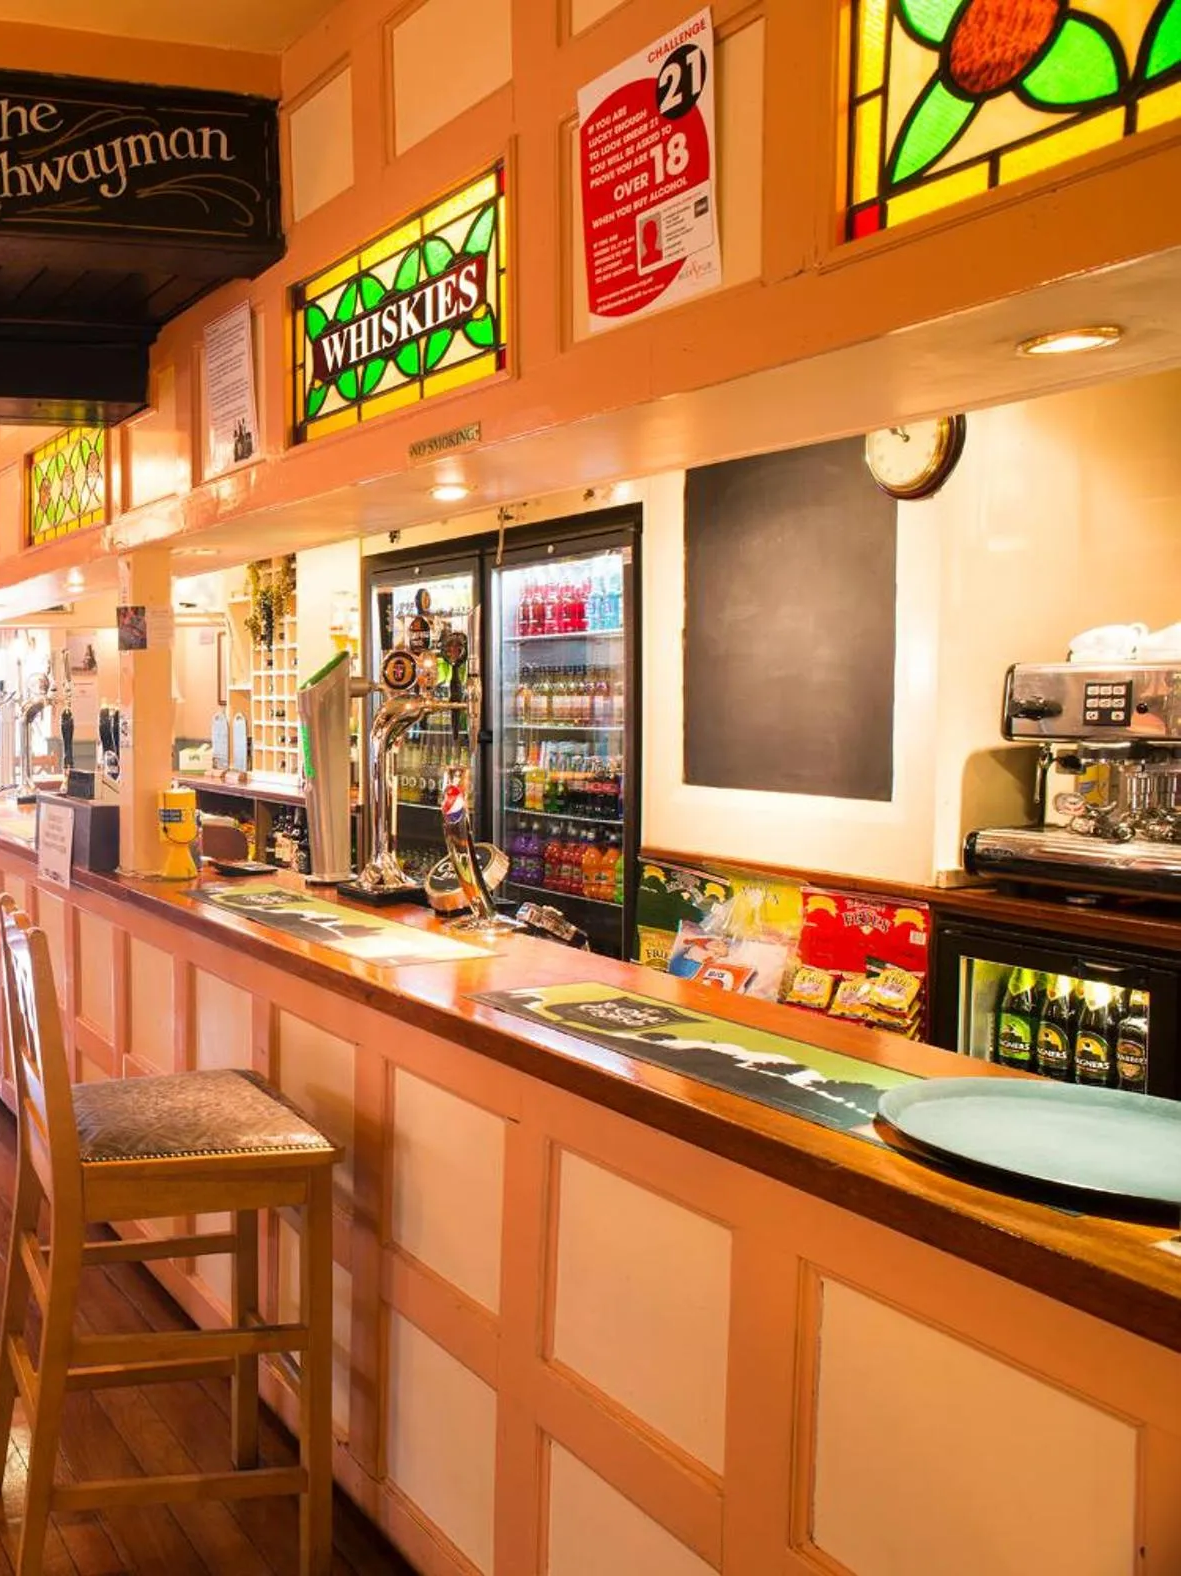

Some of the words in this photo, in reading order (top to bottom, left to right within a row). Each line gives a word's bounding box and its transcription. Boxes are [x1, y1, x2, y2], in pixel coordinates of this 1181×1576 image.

[647, 18, 707, 64] CHALLENGE
[659, 48, 703, 115] 21
[649, 132, 689, 185] 18
[613, 172, 650, 201] OVER
[321, 262, 480, 374] WHISKIES
